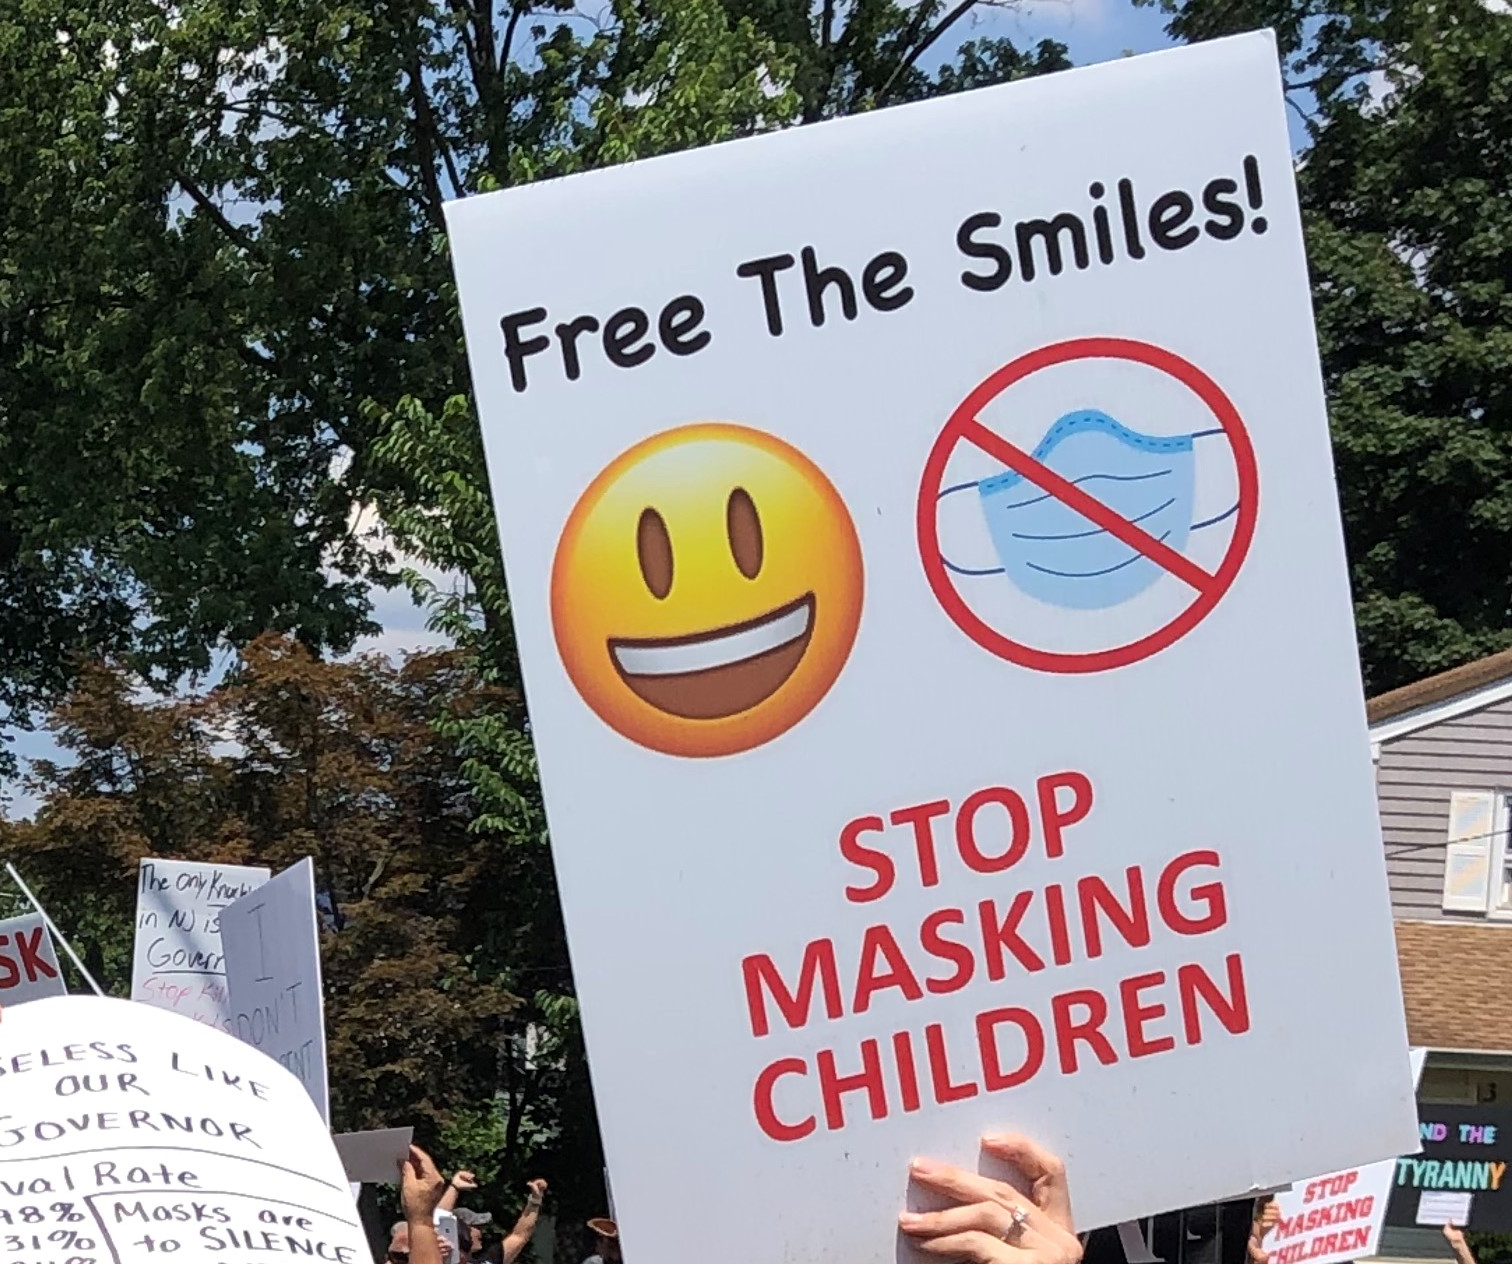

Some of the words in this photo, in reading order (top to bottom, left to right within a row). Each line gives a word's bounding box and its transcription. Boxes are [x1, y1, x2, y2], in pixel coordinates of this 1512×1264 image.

[500, 295, 711, 394] Free
[737, 244, 914, 336] The
[954, 155, 1270, 292] Smiles!
[838, 770, 1094, 904] STOP
[141, 863, 170, 893] The
[139, 912, 157, 929] in
[168, 909, 195, 931] NJ
[741, 849, 1228, 1037] MASKING
[753, 953, 1250, 1142] CHILDREN
[55, 1072, 151, 1096] OUR
[171, 1051, 270, 1102] LIKE
[1458, 1124, 1497, 1144] THE
[94, 1161, 203, 1188] Rate
[1303, 1171, 1358, 1204] STOP
[1397, 1158, 1506, 1190] TYRANNY
[114, 1201, 231, 1223] Masks
[258, 1209, 314, 1231] are
[1275, 1195, 1374, 1241] MASKING
[133, 1234, 181, 1253] to
